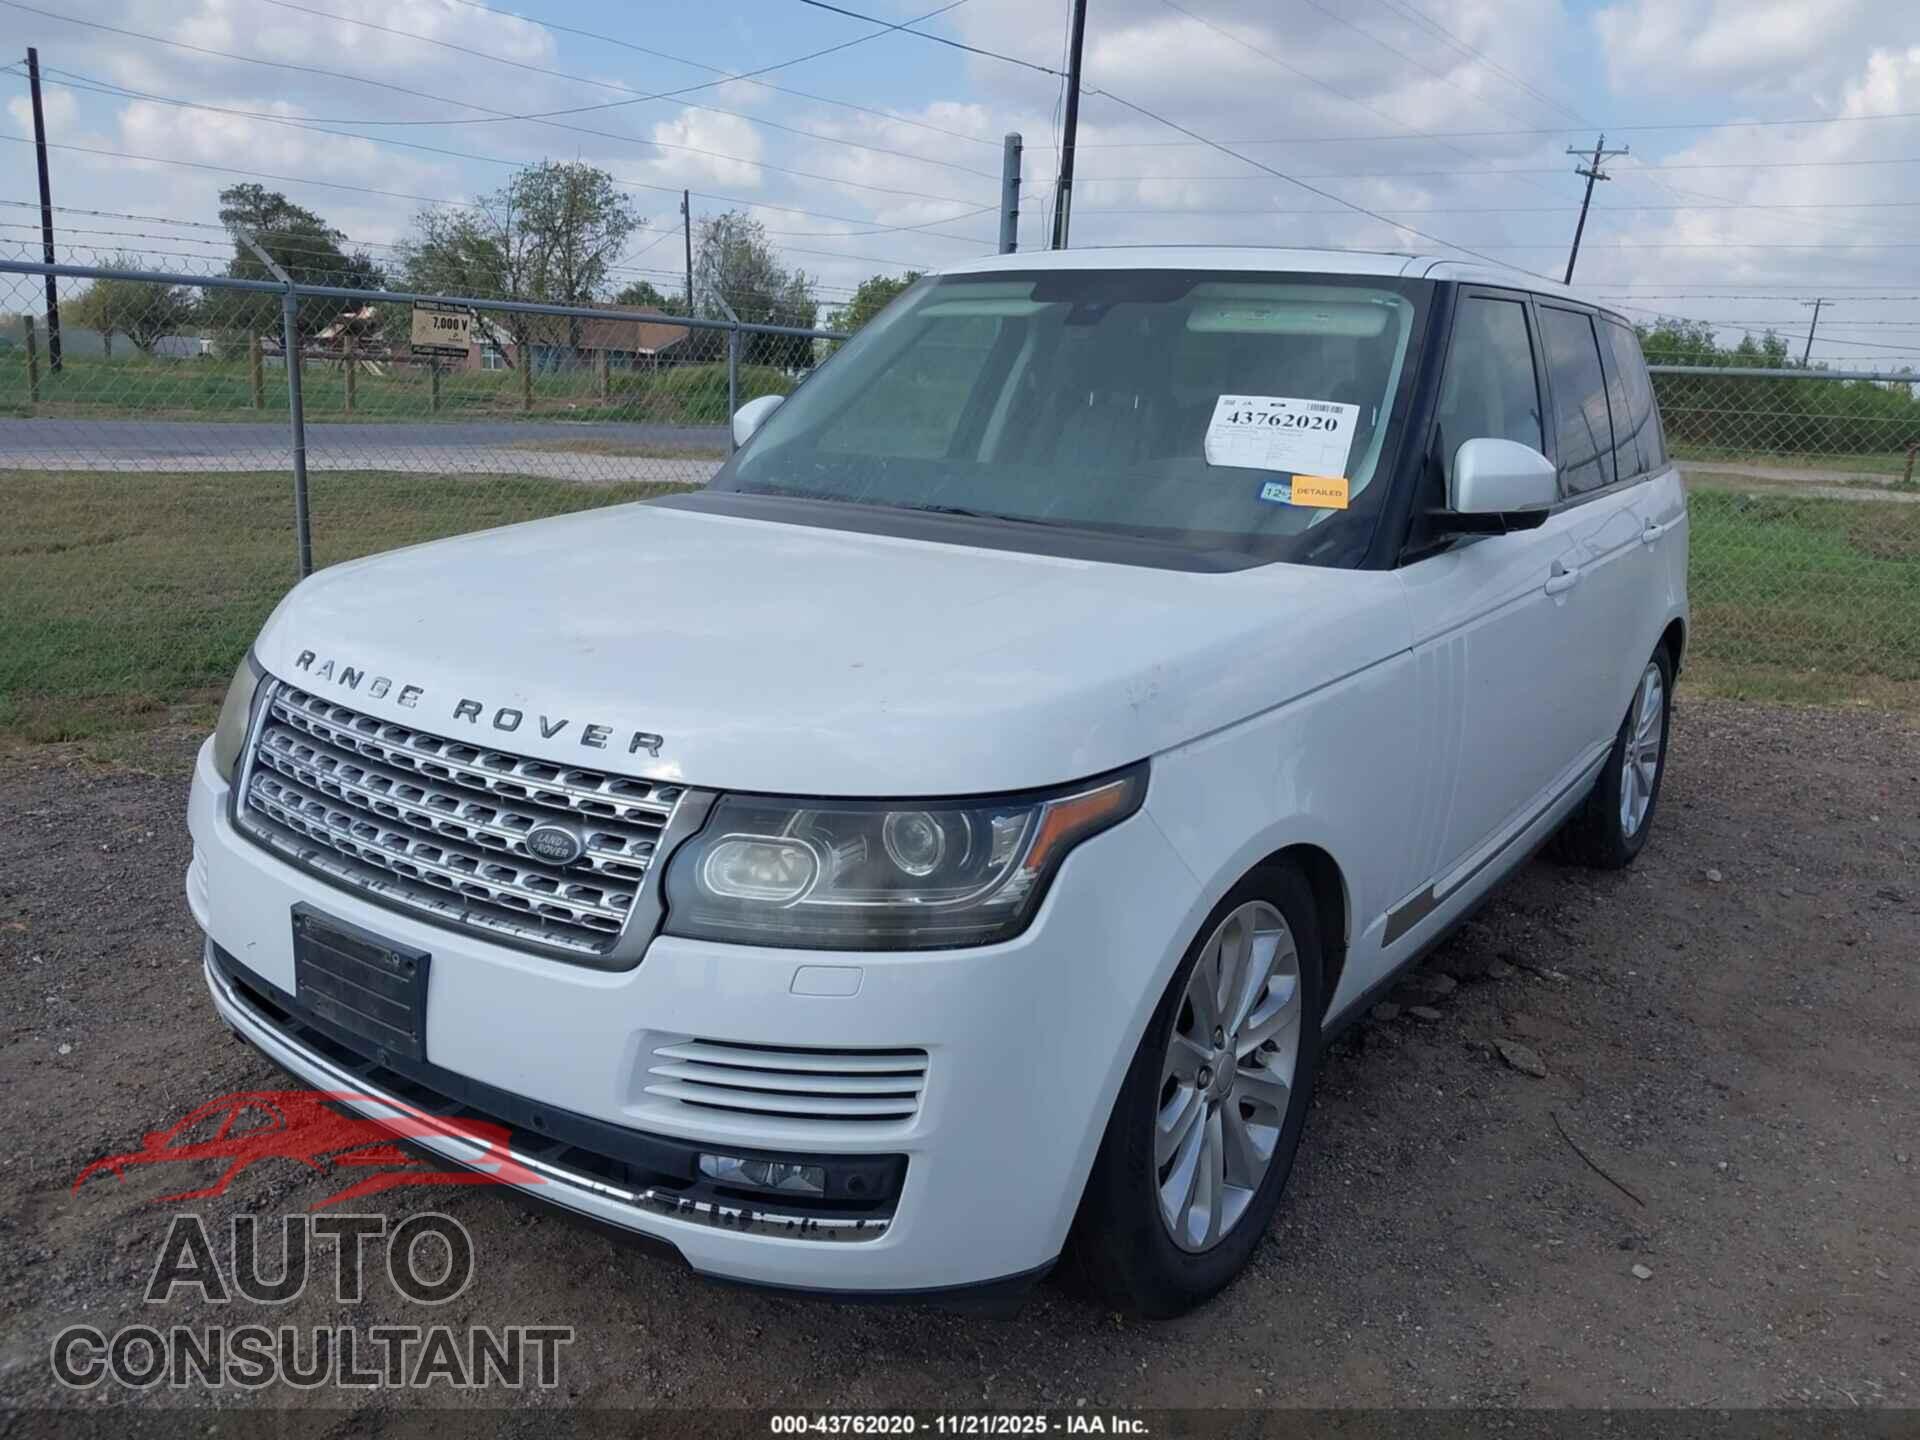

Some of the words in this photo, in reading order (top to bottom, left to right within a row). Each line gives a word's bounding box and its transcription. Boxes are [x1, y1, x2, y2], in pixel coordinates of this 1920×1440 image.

[461, 319, 468, 332] V
[1227, 410, 1338, 432] 43762020
[1296, 487, 1343, 497] DETAILED
[295, 649, 424, 708] RANGE
[452, 698, 664, 758] ROVER
[536, 832, 562, 847] LAND
[538, 843, 570, 858] ROVER
